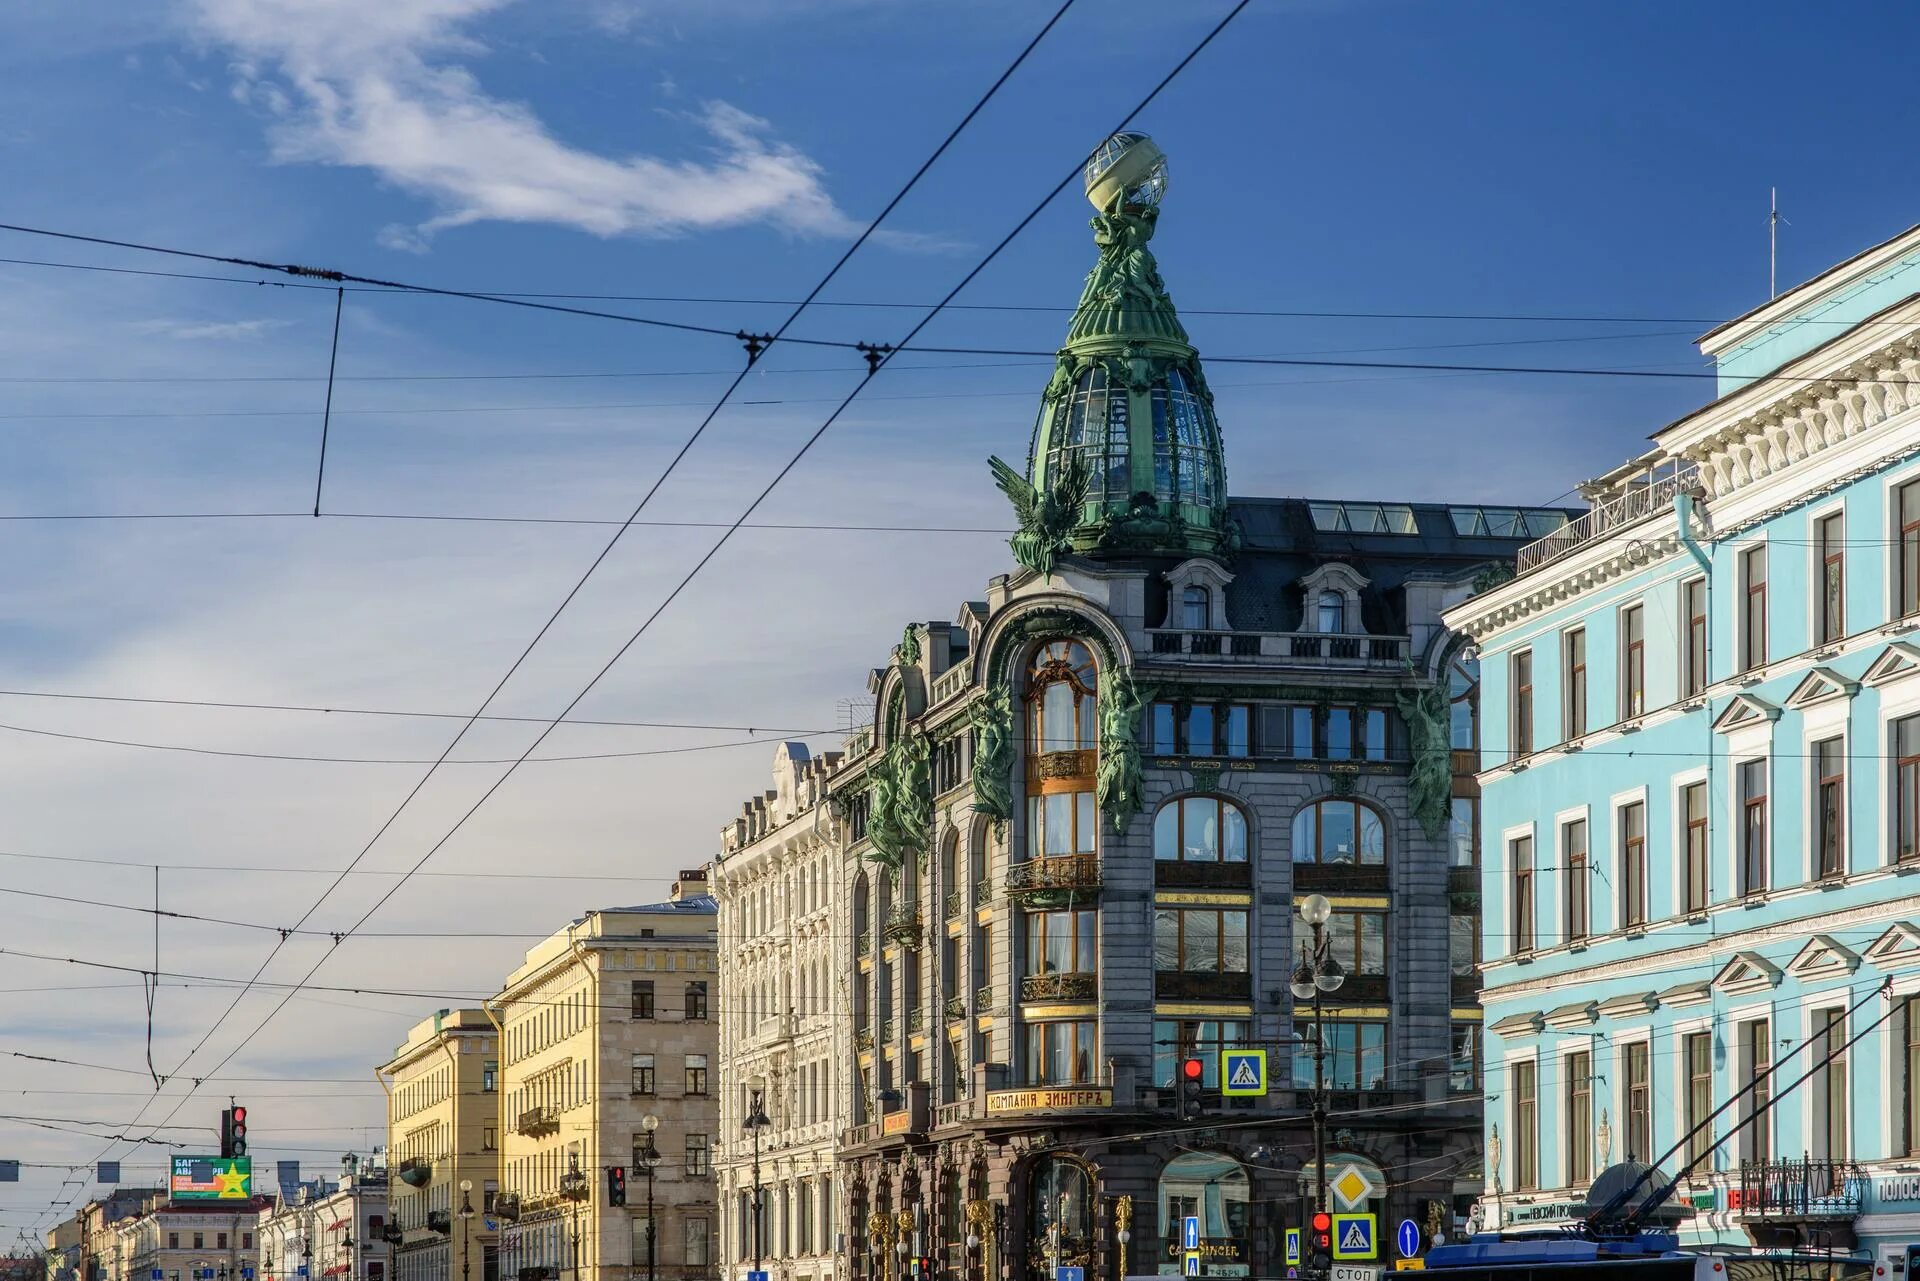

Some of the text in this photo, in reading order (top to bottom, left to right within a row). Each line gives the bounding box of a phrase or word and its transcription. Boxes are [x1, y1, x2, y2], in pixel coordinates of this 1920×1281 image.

[991, 1092, 1102, 1109] КОМПАНІЯ ЗИНГЕРЪ
[1879, 1178, 1920, 1200] ПОЛОС
[1322, 1235, 1329, 1247] 9
[1337, 1269, 1371, 1280] СТОП
